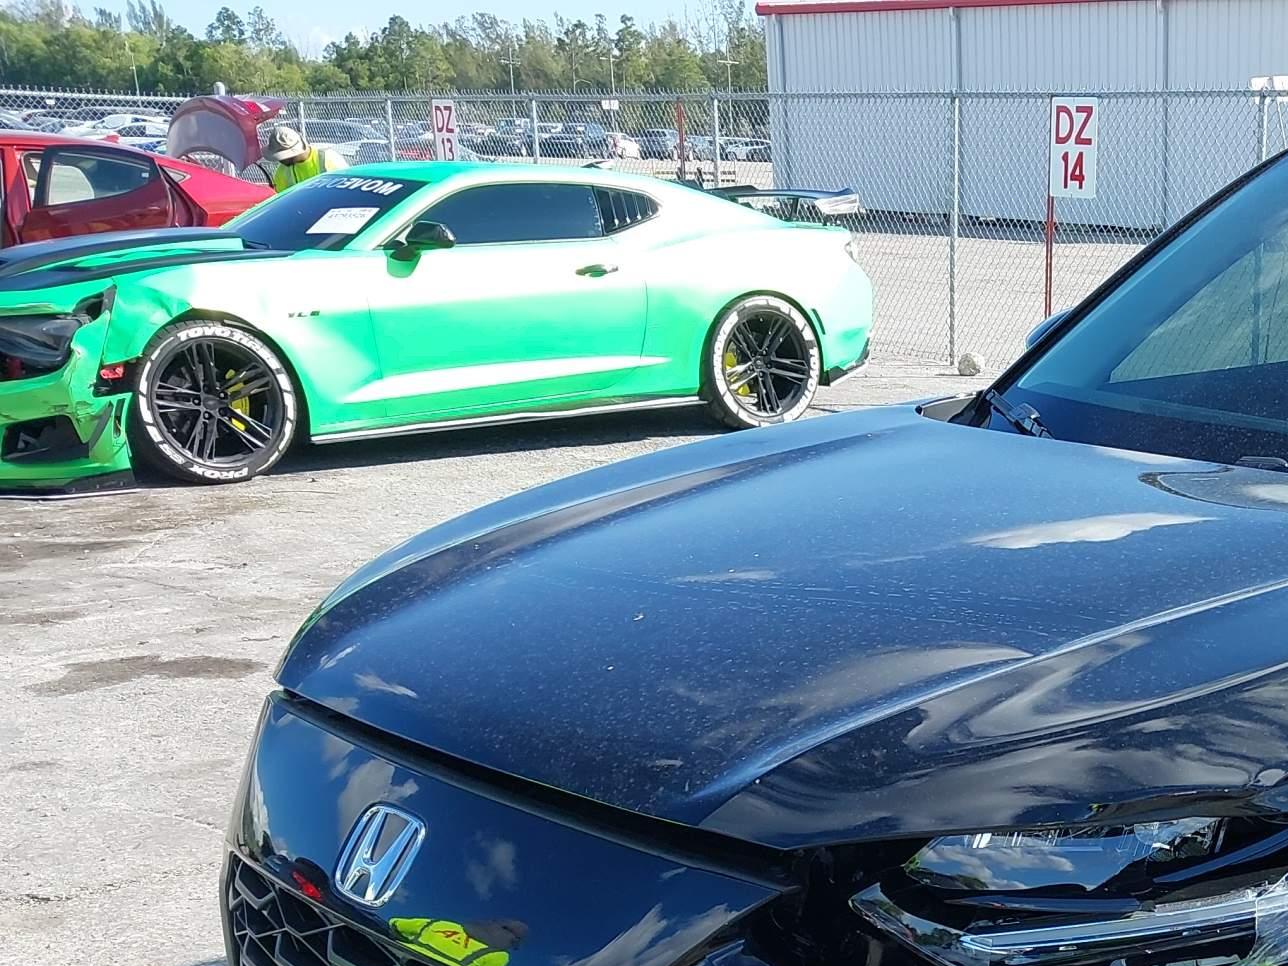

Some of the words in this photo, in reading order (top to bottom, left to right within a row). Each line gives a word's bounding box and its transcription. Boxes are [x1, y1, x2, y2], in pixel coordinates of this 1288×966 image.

[434, 105, 455, 133] DZ
[1055, 105, 1094, 145] DZ
[441, 137, 455, 161] 13
[1061, 151, 1085, 189] 14
[176, 326, 231, 342] TOYO
